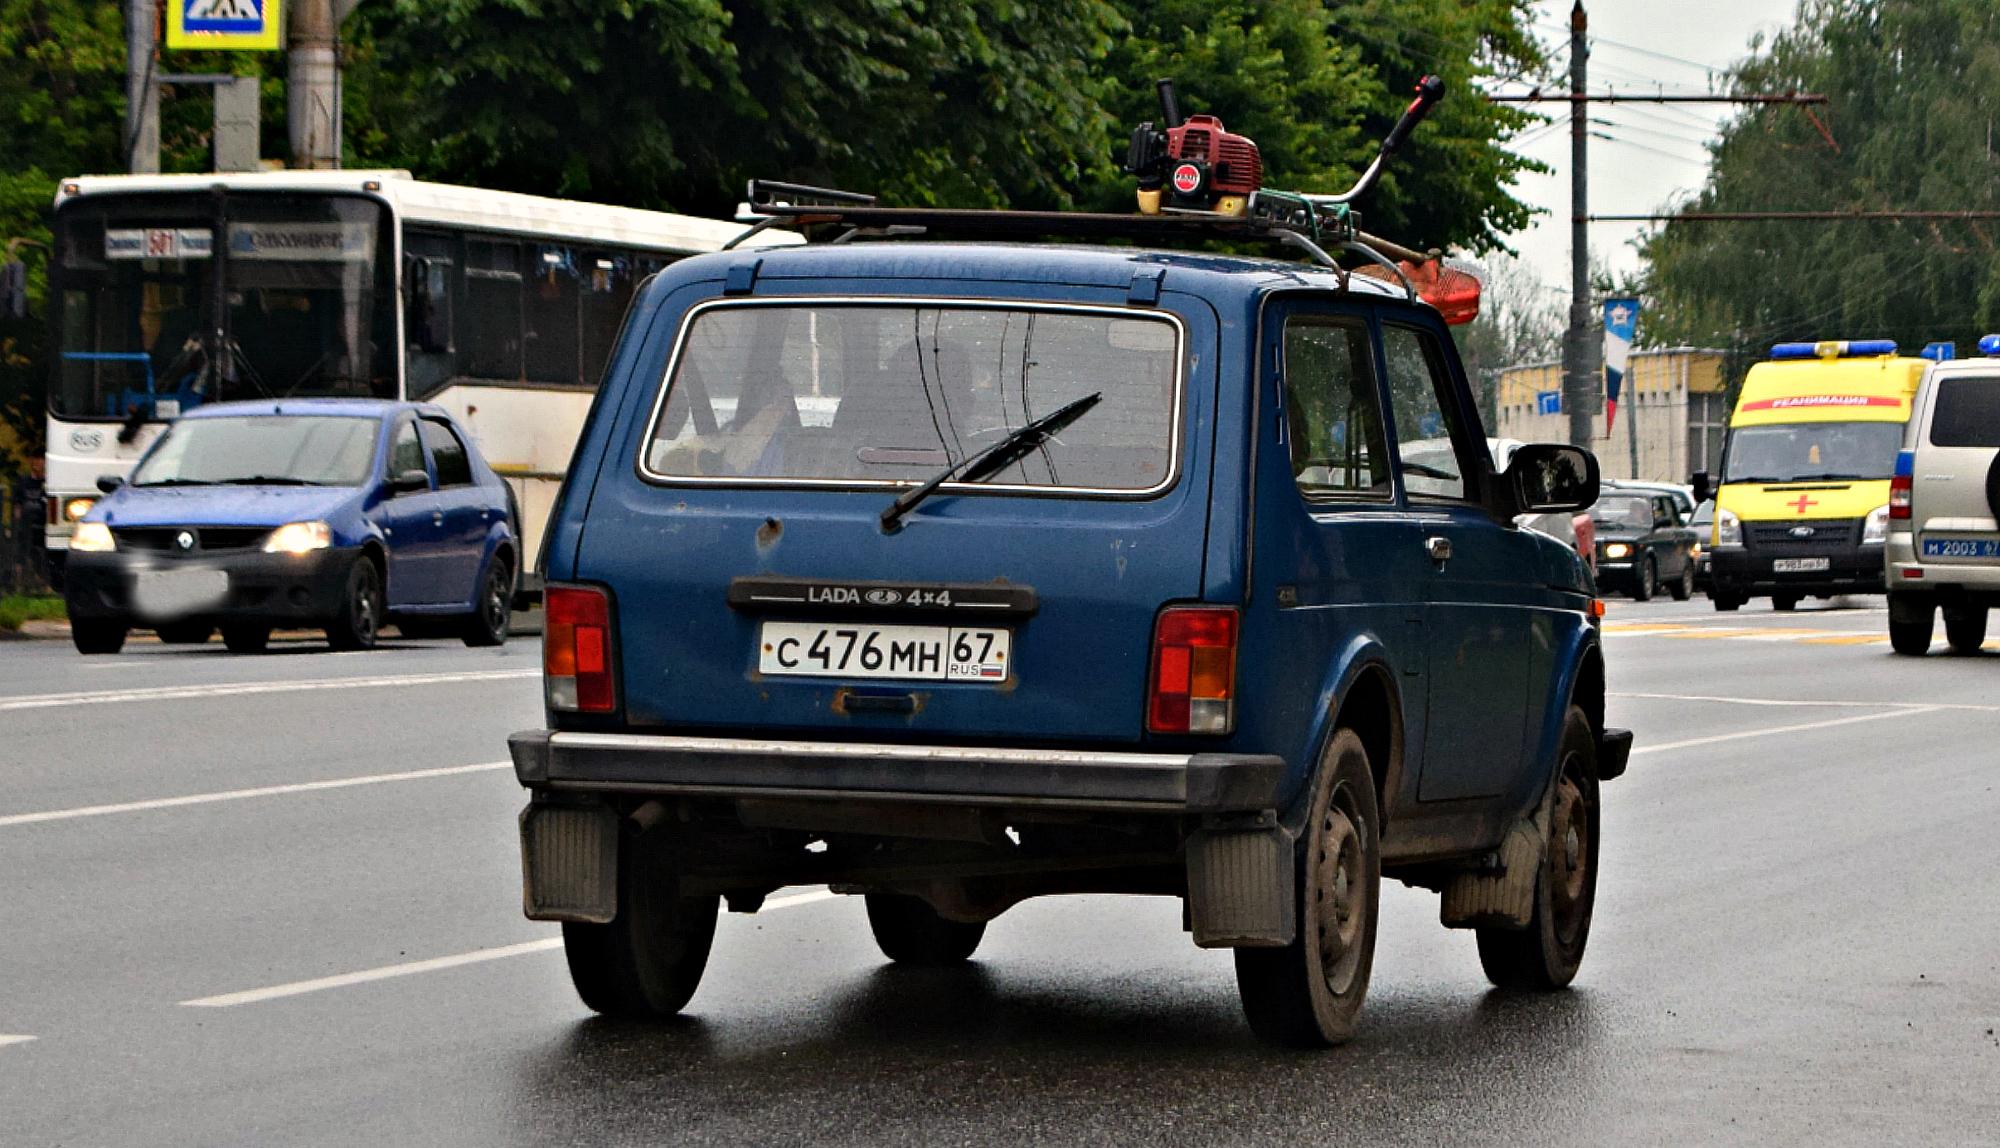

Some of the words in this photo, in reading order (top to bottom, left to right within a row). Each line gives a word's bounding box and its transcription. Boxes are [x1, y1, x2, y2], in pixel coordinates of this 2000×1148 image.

[1943, 541, 1977, 555] 2003
[808, 587, 860, 604] LADA
[953, 632, 995, 664] 67
[950, 664, 979, 676] RUS
